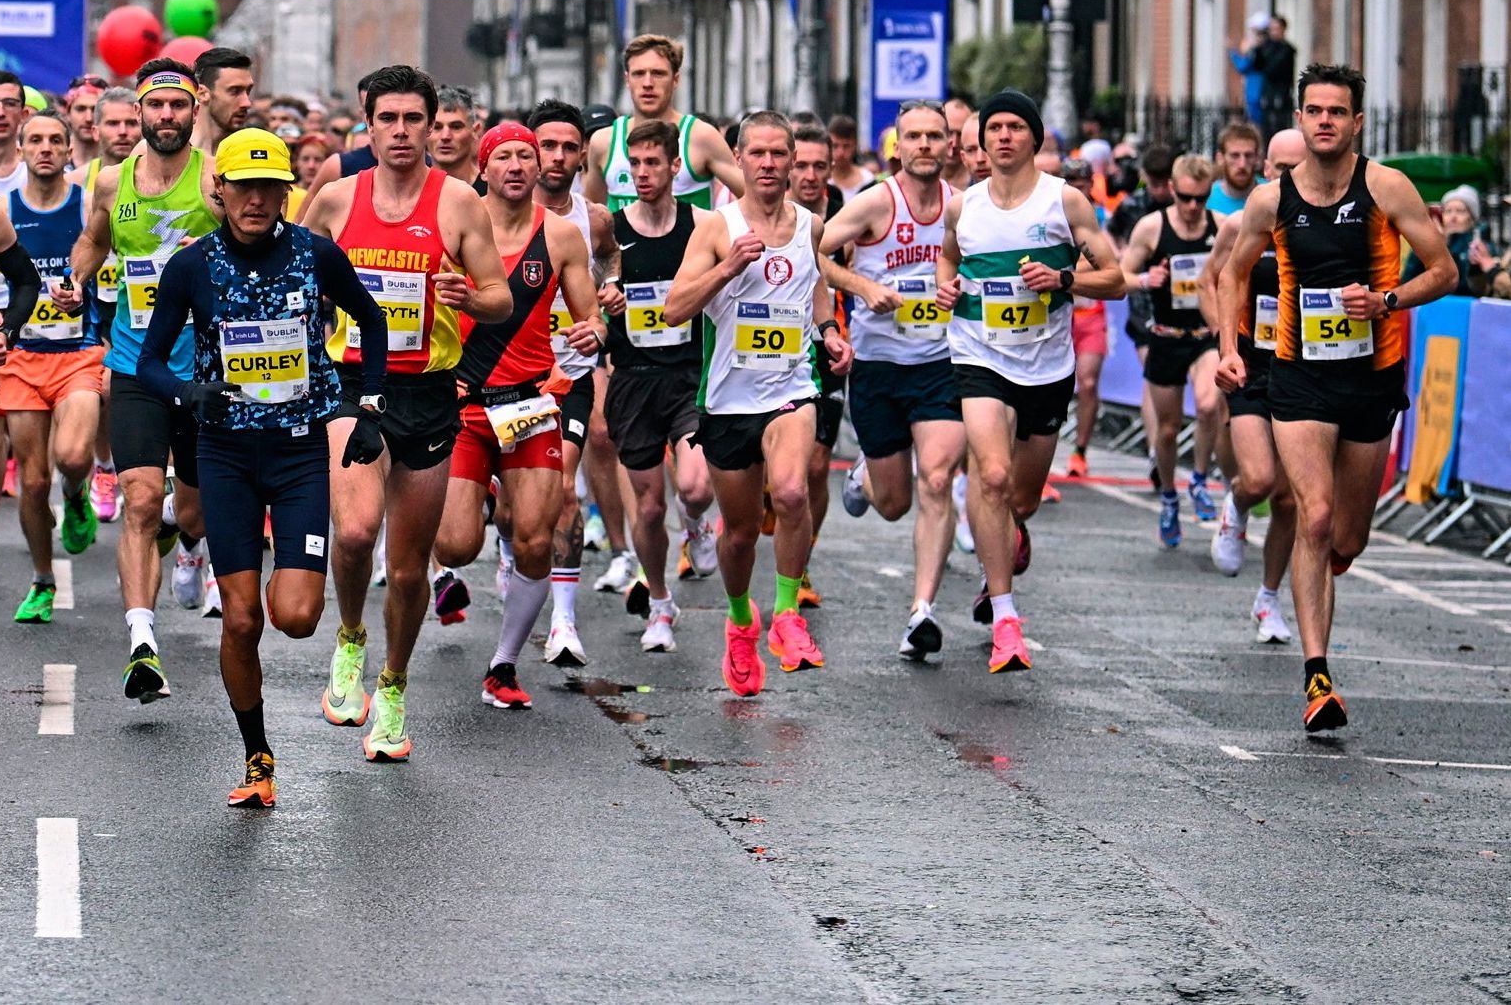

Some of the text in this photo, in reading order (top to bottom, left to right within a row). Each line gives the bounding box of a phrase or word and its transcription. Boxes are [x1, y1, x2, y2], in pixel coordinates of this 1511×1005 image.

[50, 258, 63, 267] ON
[347, 248, 430, 272] NEWCASTLE
[387, 280, 418, 289] DUBLIN
[381, 306, 419, 318] SYTH
[912, 302, 938, 321] 65
[1001, 306, 1030, 325] 47
[266, 328, 298, 336] DUBLIN
[1320, 318, 1352, 339] 54
[751, 329, 785, 350] 50
[227, 353, 303, 372] CURLEY
[261, 372, 271, 381] 12
